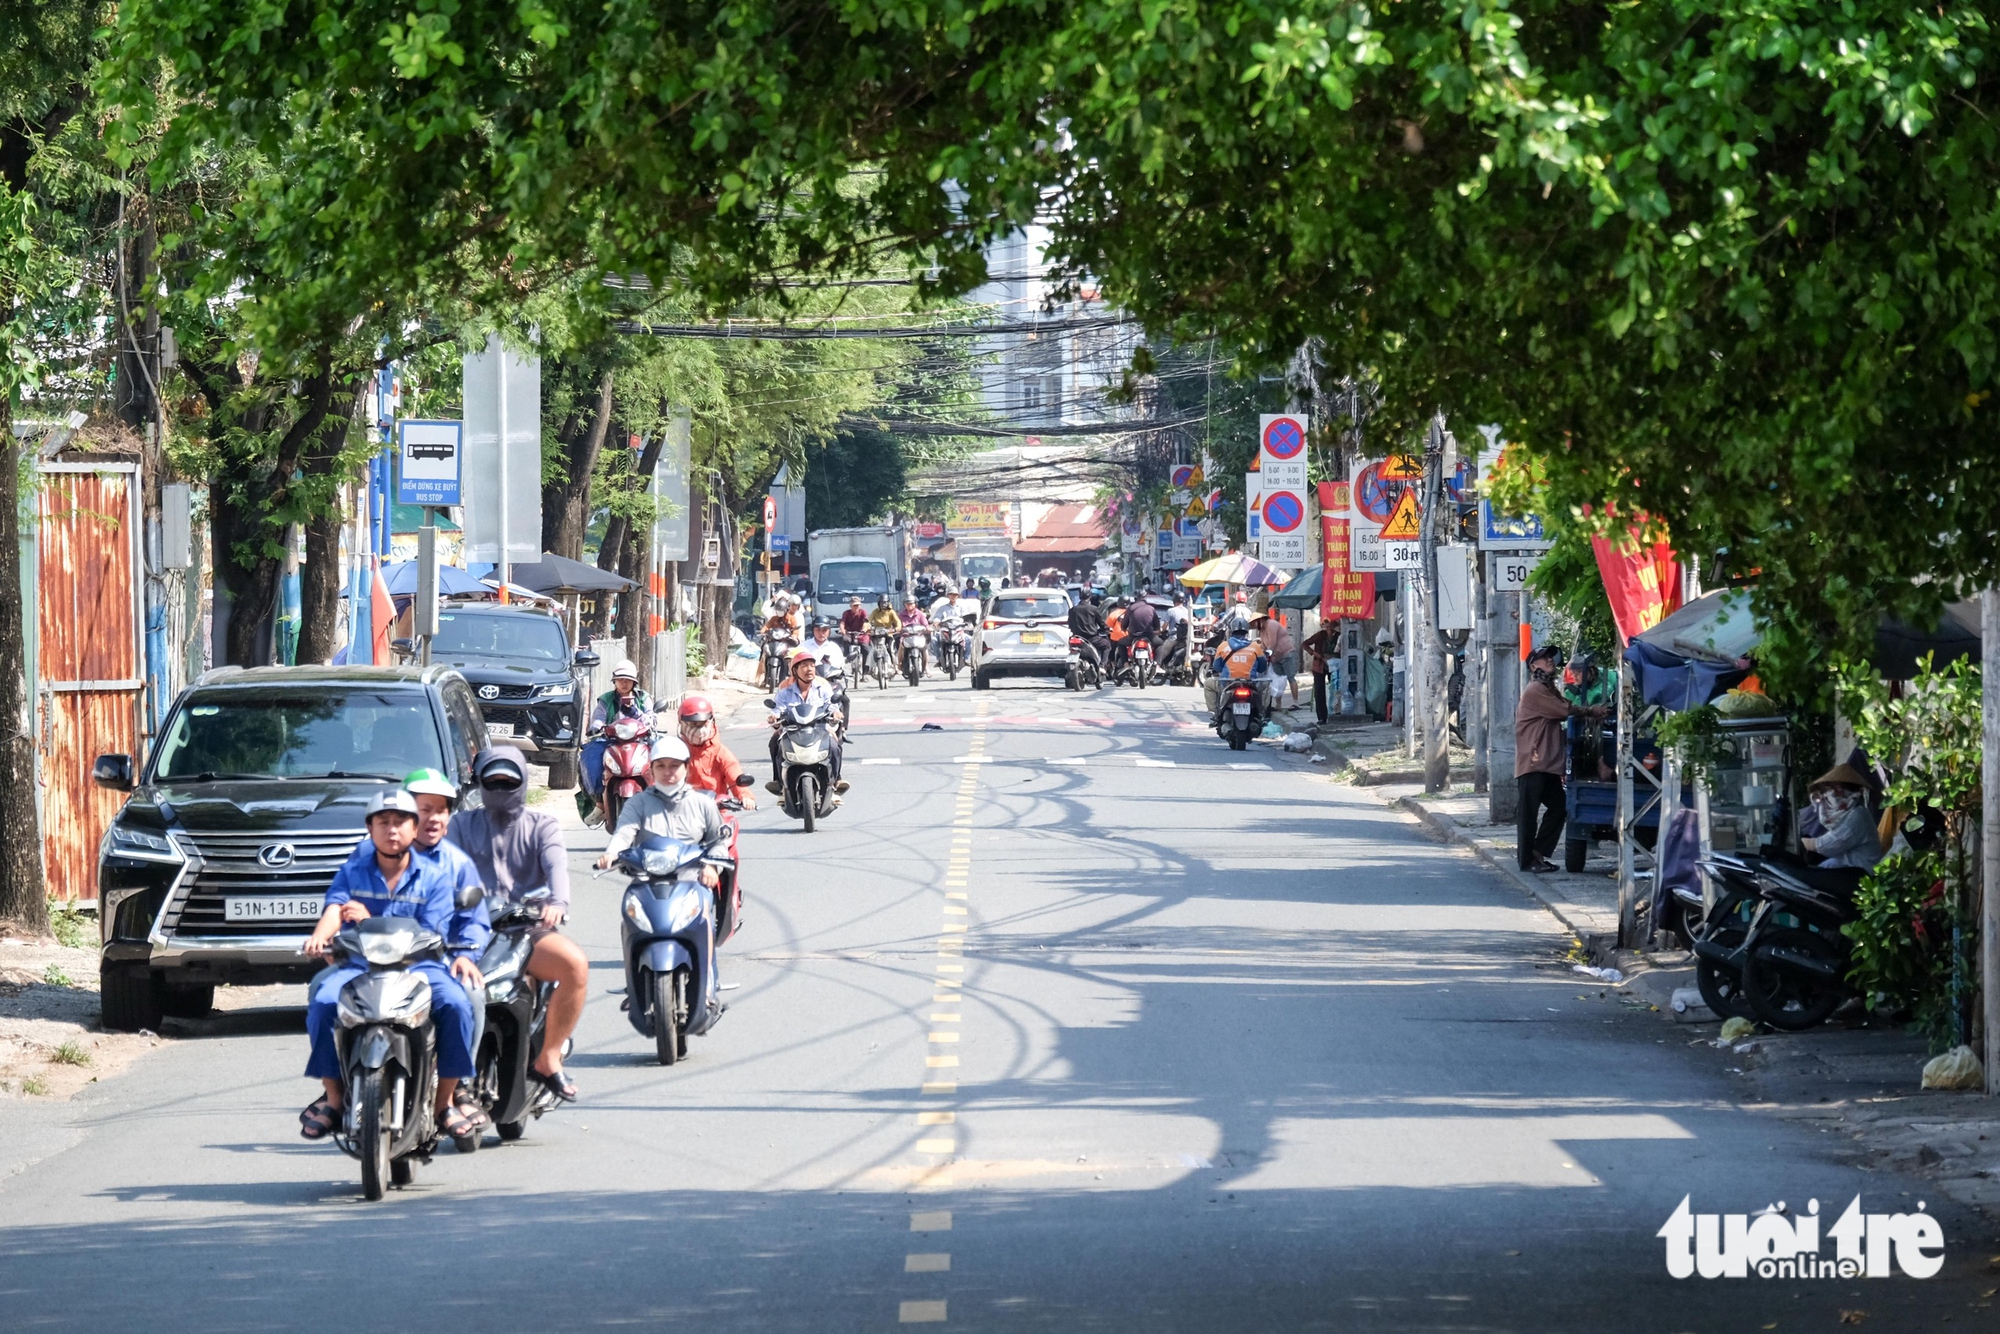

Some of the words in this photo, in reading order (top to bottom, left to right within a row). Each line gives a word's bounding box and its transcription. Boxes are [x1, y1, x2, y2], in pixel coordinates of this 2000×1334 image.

[434, 482, 442, 491] XE
[416, 493, 428, 501] BUS
[428, 493, 443, 502] STOP
[1393, 548, 1409, 561] 30
[1507, 565, 1527, 582] 50
[234, 901, 318, 916] 51N-131.68
